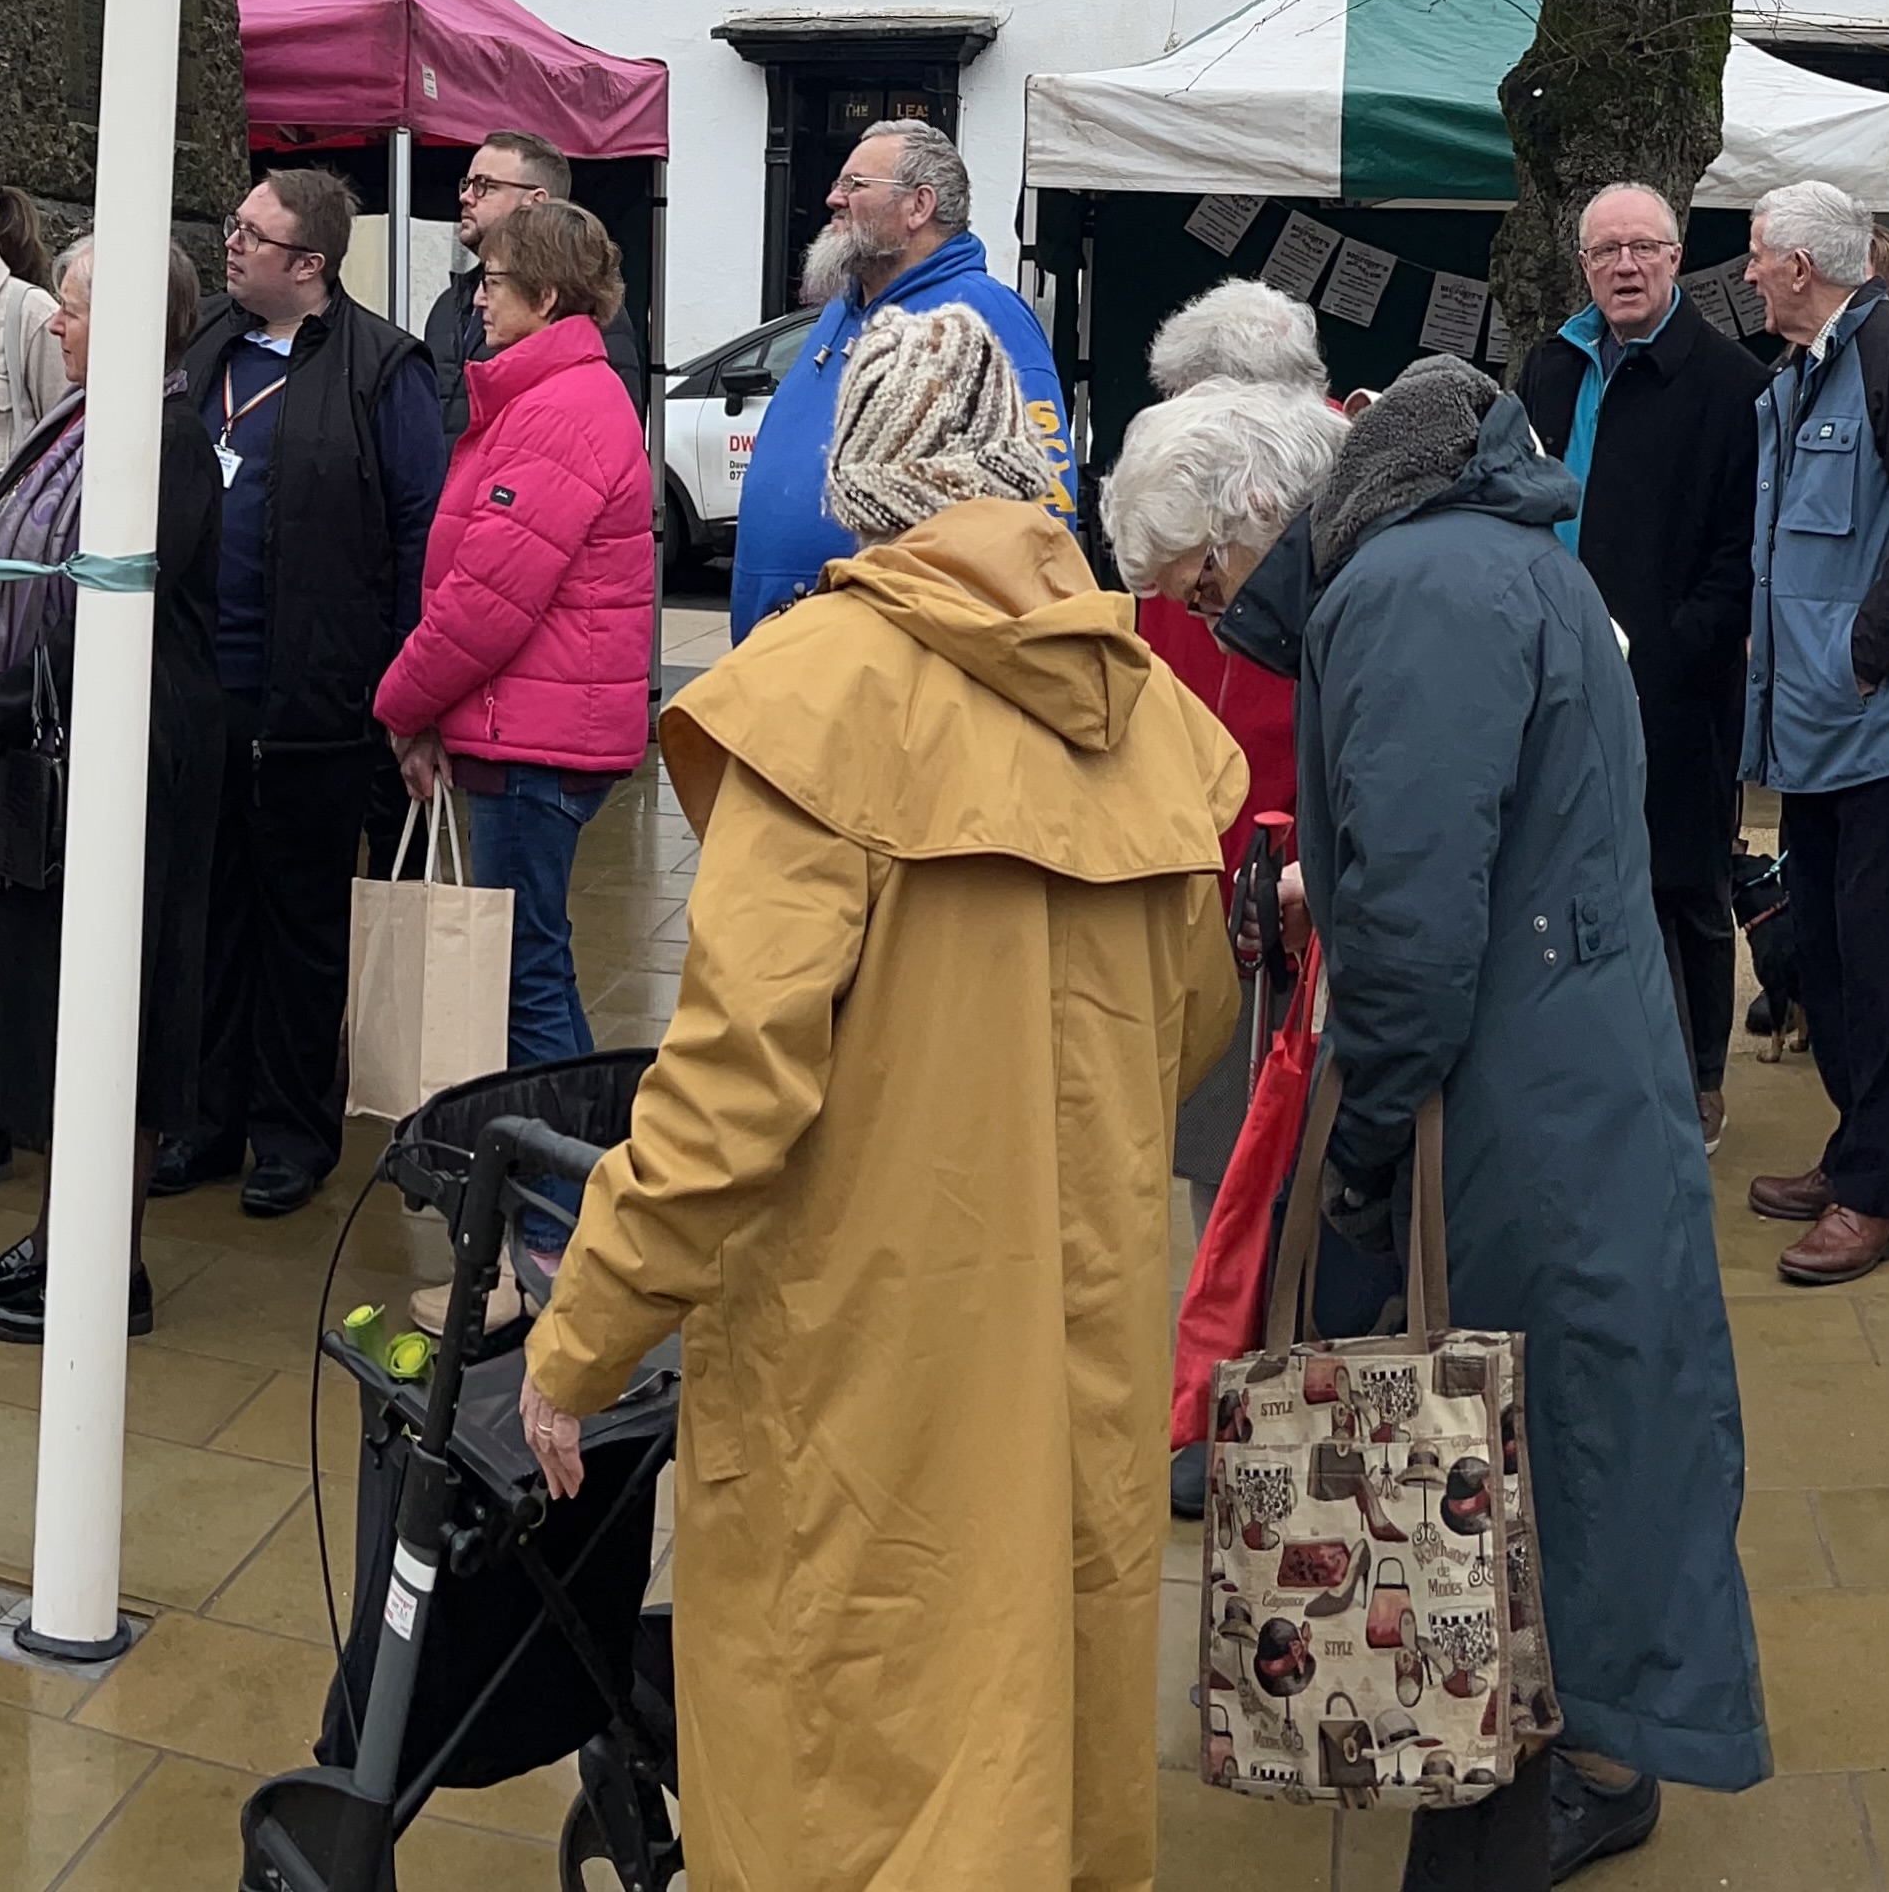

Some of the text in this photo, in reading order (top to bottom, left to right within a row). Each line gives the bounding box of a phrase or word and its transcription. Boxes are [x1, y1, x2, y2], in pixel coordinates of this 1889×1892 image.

[845, 103, 869, 118] THE
[1260, 1400, 1295, 1417] STYLE
[1437, 1564, 1450, 1578] de
[1428, 1578, 1464, 1597] Modes
[1324, 1640, 1354, 1657] STYLE
